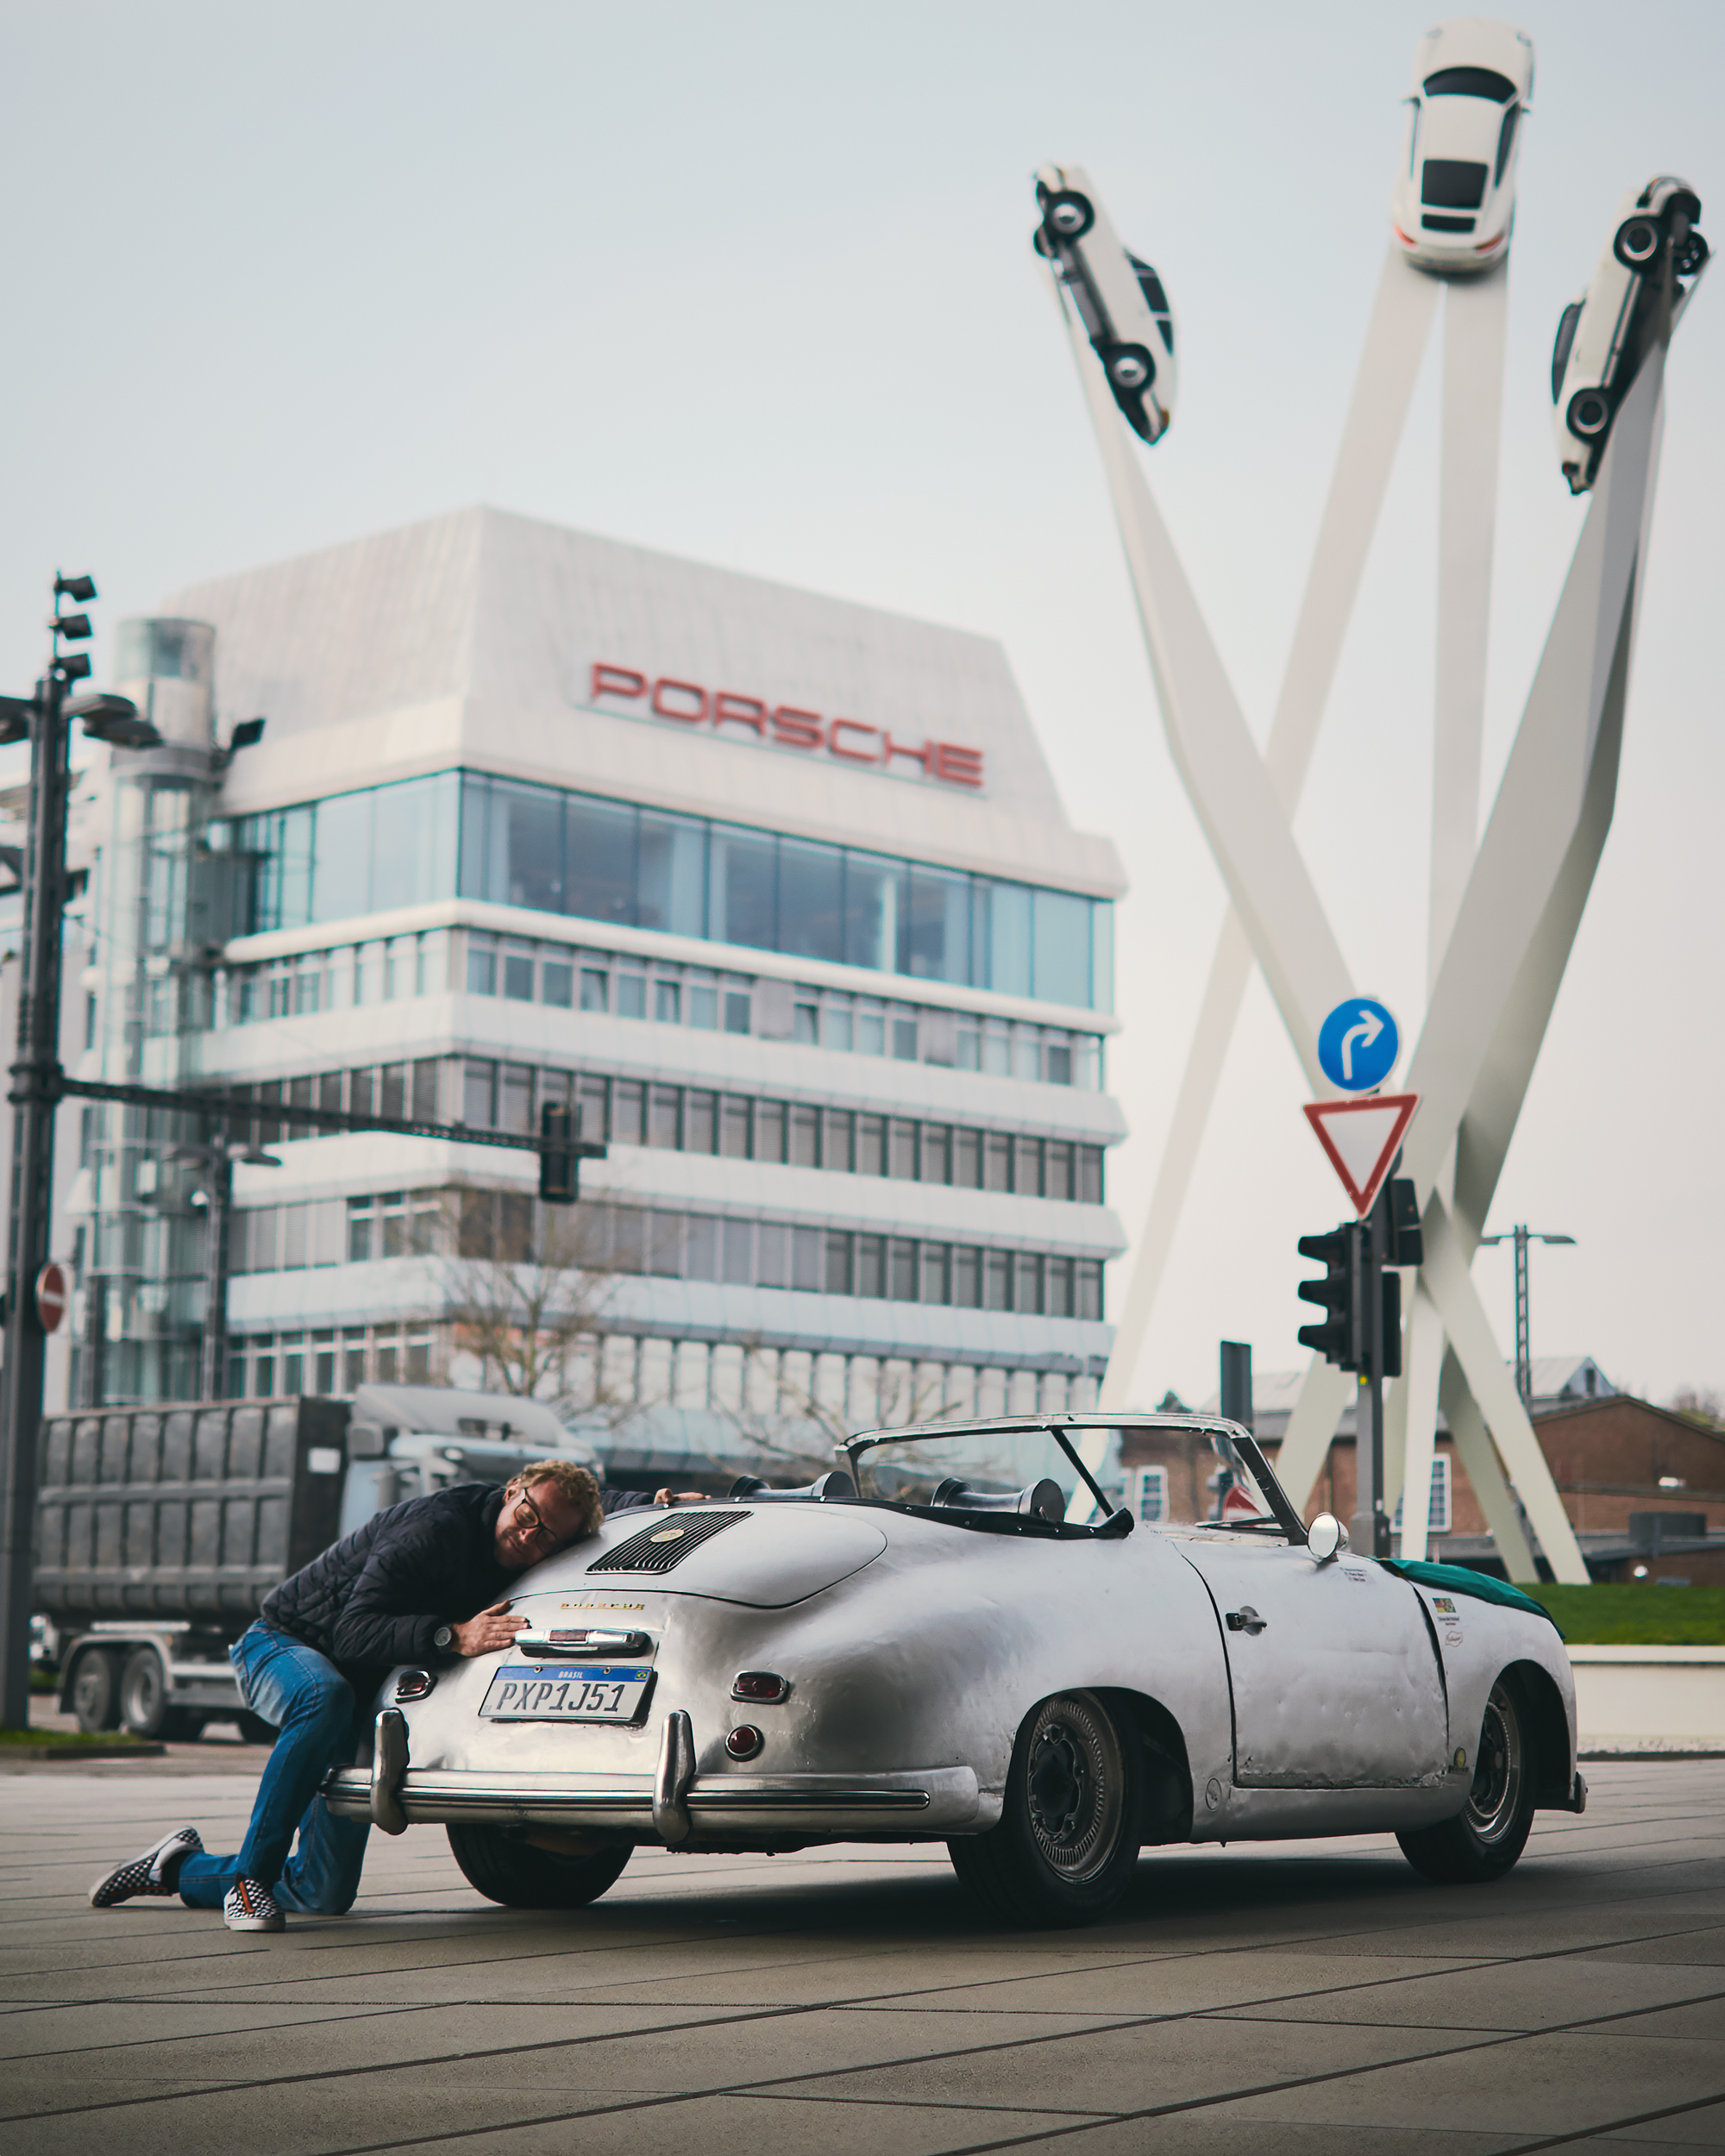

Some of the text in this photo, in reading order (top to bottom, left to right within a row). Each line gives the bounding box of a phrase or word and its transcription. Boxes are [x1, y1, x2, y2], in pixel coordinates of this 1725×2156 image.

[591, 662, 984, 787] PORSCHE
[558, 1670, 584, 1679] BRASIL
[496, 1683, 624, 1712] PXP1J51
